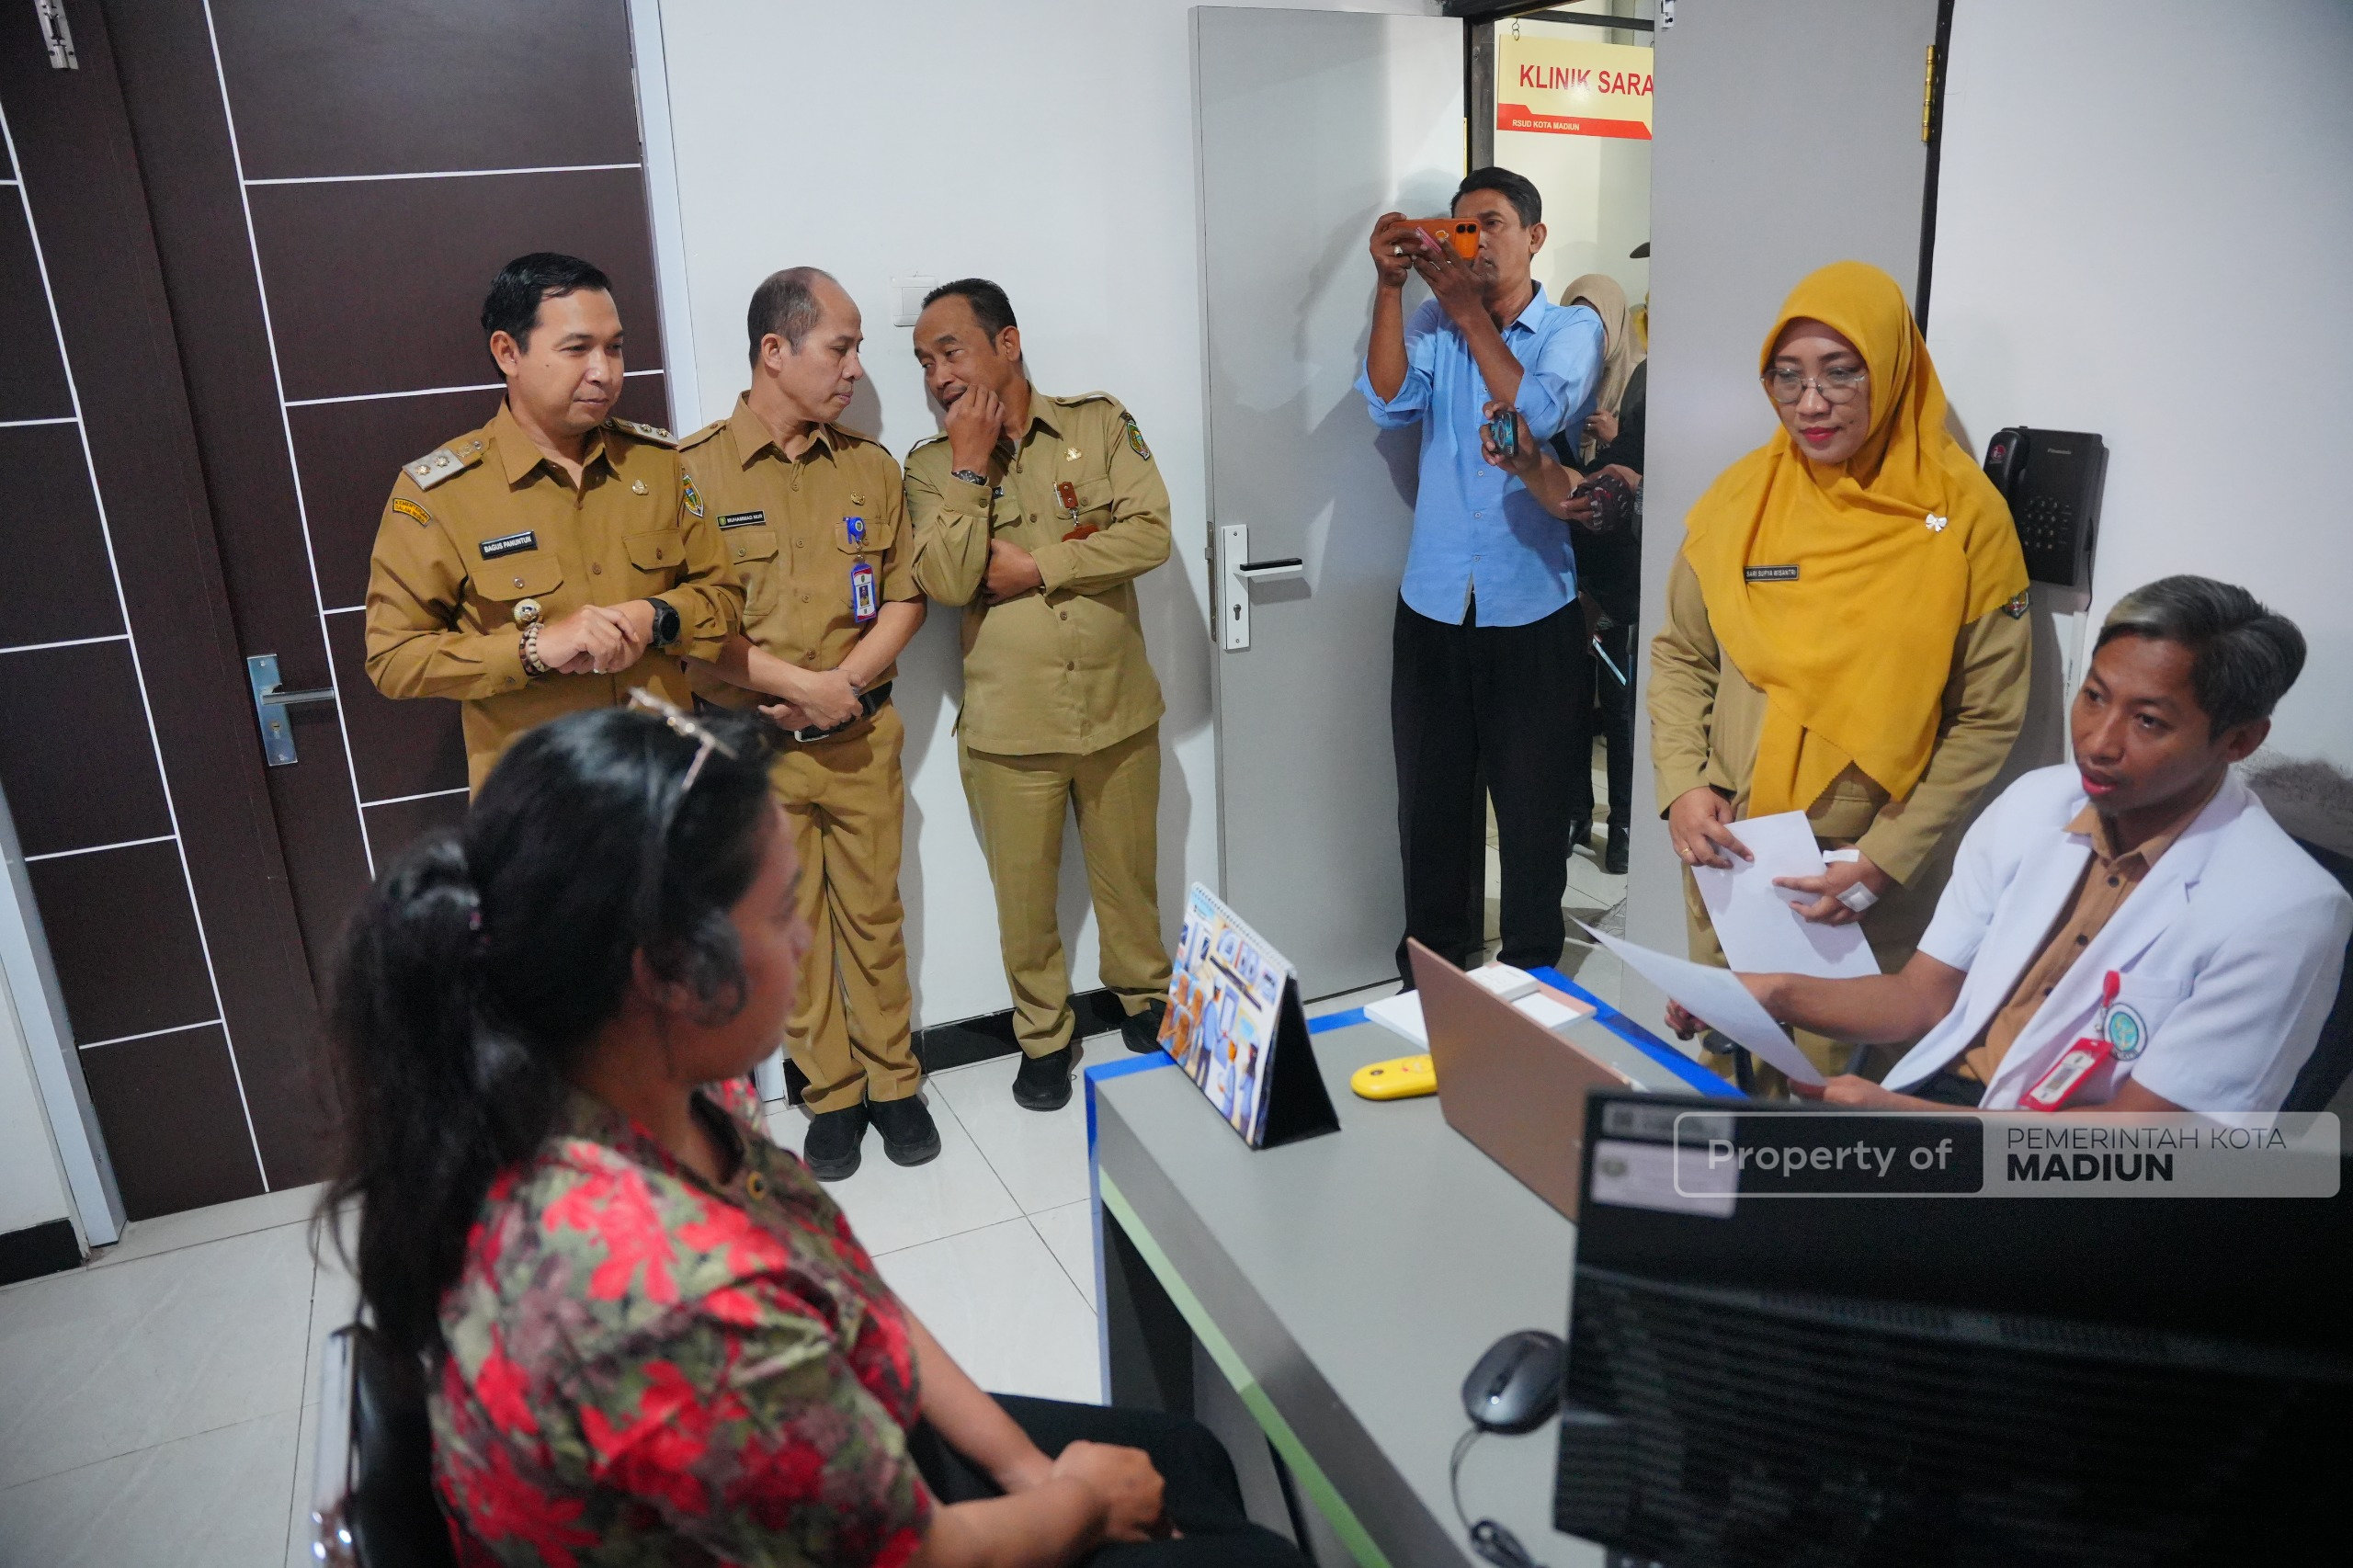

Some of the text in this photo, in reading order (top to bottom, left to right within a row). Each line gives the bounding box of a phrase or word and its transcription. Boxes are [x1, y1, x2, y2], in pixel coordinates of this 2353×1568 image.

[1520, 64, 1654, 97] KLINIK SARA
[1512, 119, 1580, 131] RSUD KOTA MADIUN
[484, 536, 531, 552] BAGUS PANUNTUN
